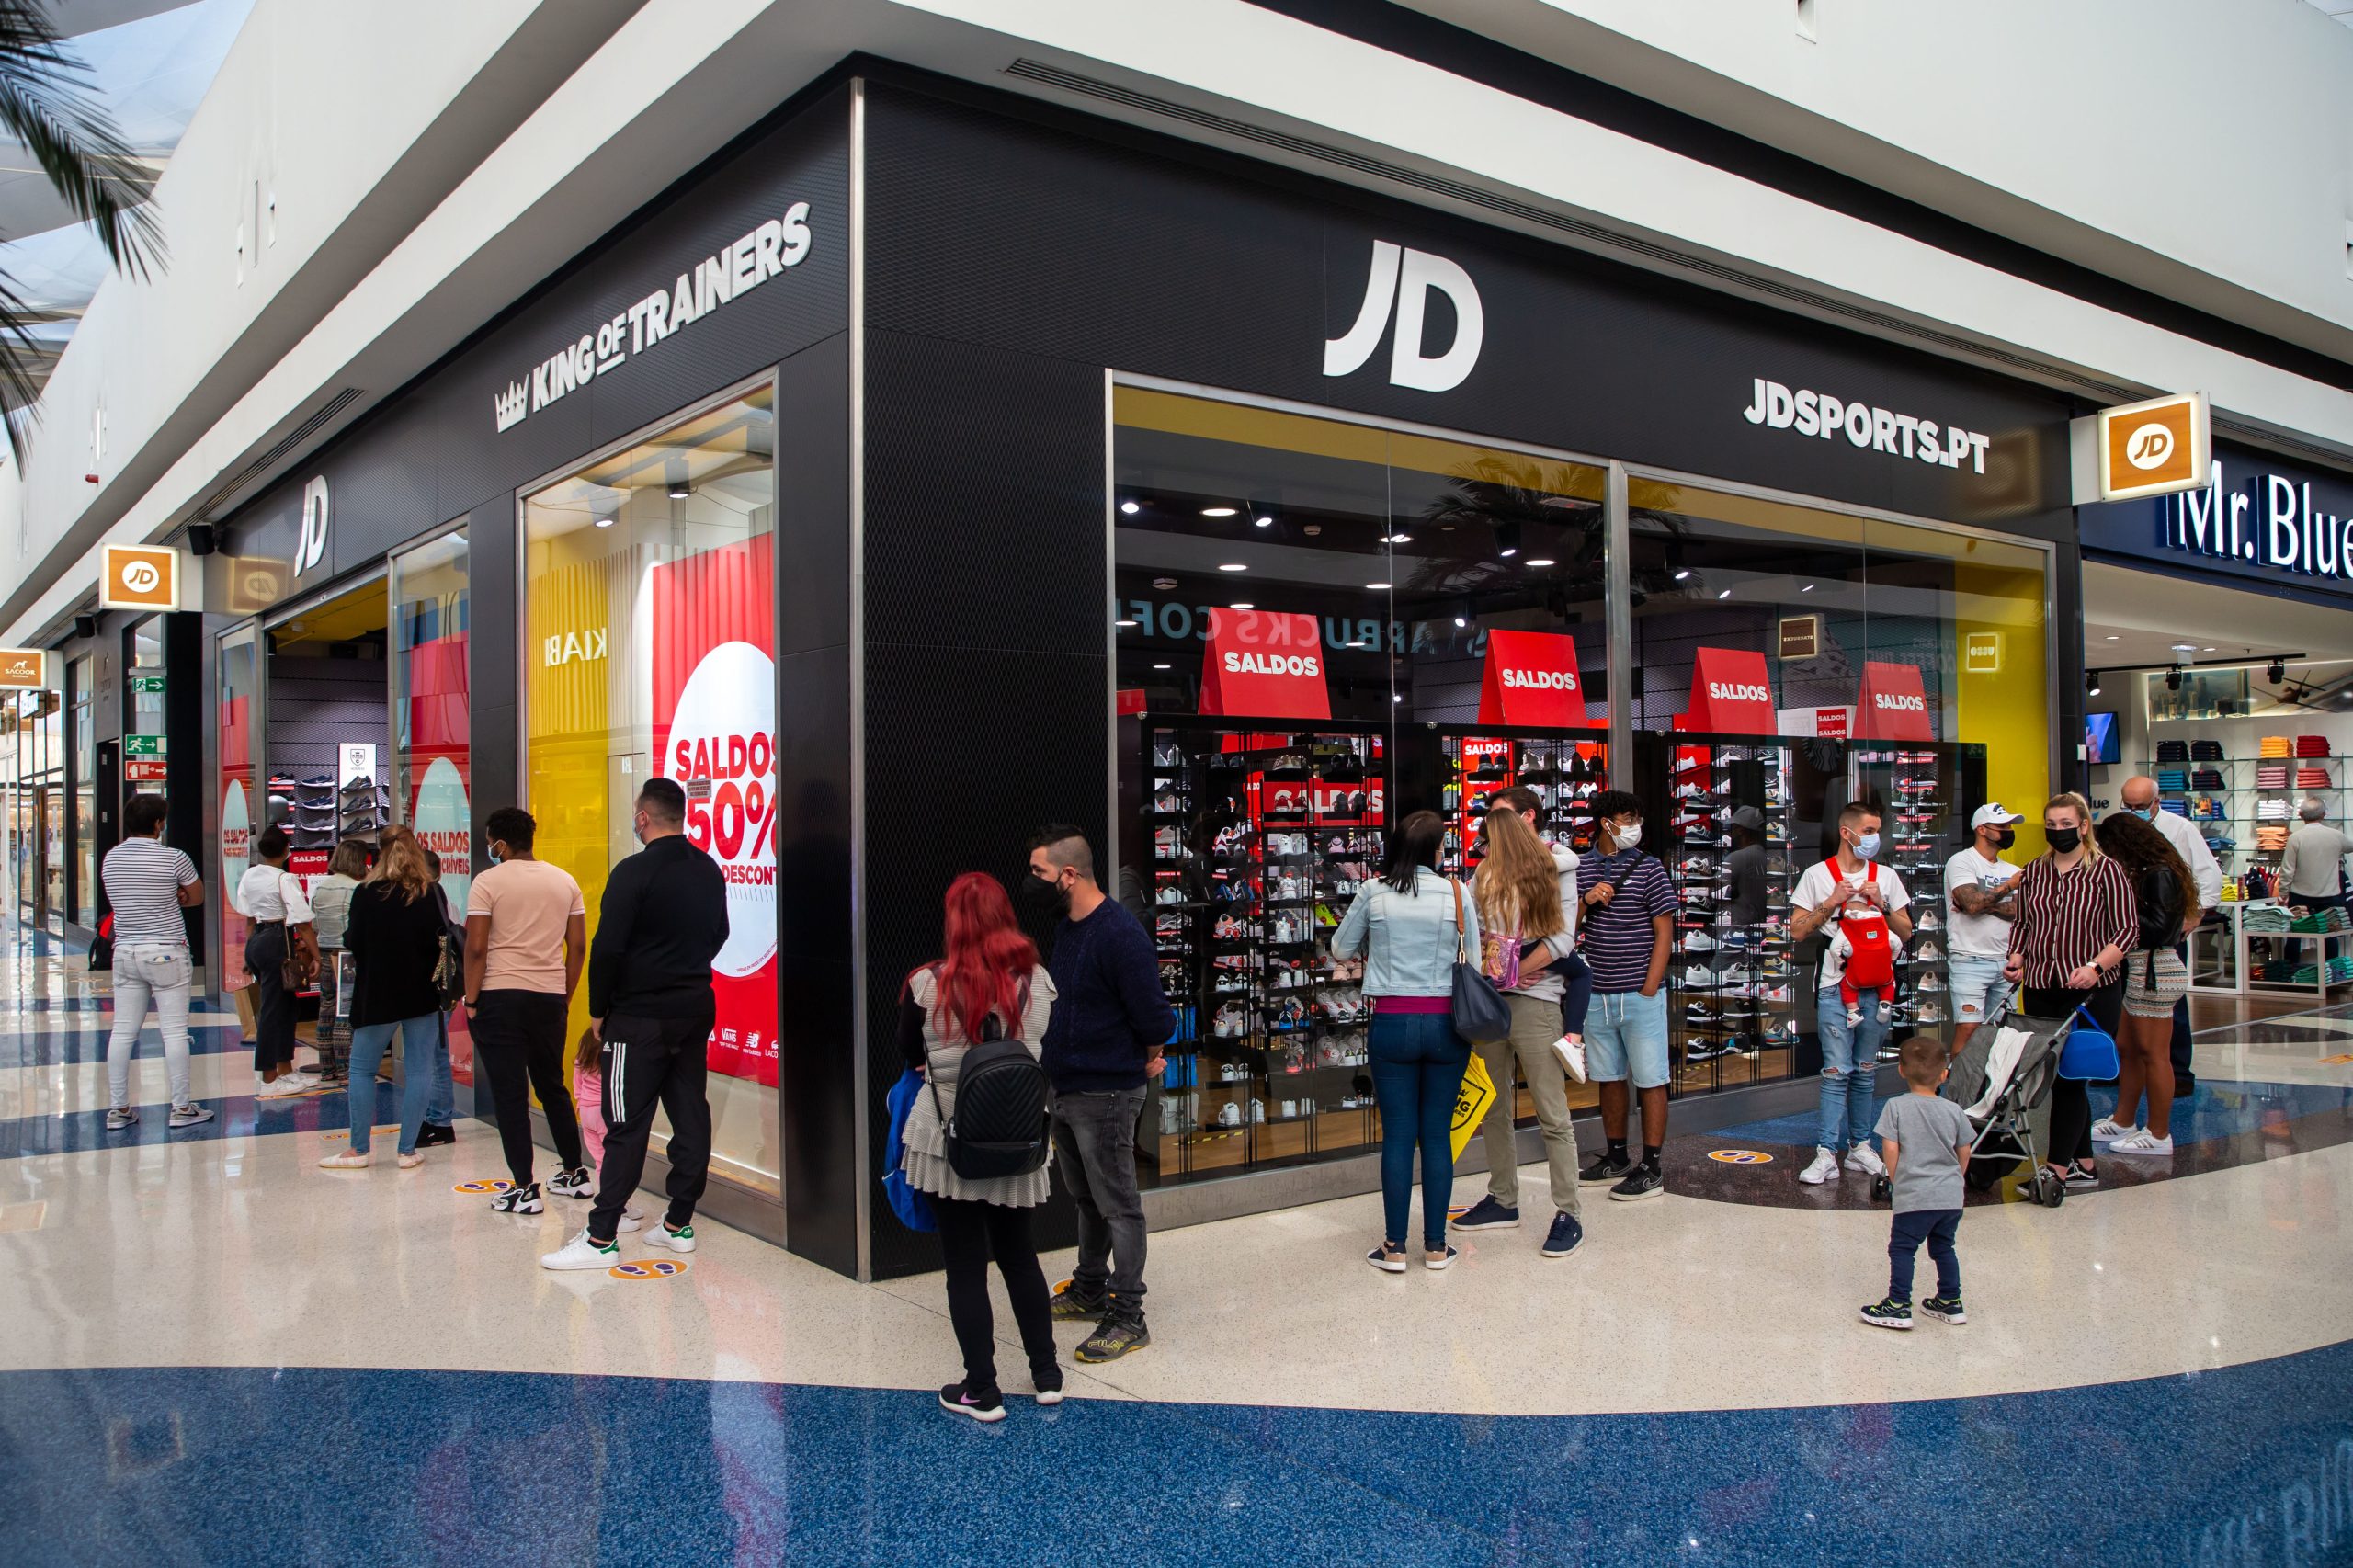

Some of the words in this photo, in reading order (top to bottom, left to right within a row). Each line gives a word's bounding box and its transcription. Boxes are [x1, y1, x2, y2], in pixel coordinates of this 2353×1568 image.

[532, 335, 595, 414] KING
[597, 312, 627, 361] OF
[628, 201, 812, 356] TRAINERS
[1323, 240, 1483, 392] JD
[1743, 378, 1990, 475] JDSPORTS.PT
[2134, 432, 2168, 460] JD
[2177, 460, 2255, 560] Mr.
[295, 474, 329, 578] JD
[128, 568, 154, 585] JD
[1225, 651, 1319, 676] SALDOS
[1503, 668, 1575, 690] SALDOS
[1710, 681, 1768, 702] SALDOS
[1875, 693, 1925, 711] SALDOS
[1465, 742, 1508, 755] SALDOS
[687, 780, 778, 861] 50%
[416, 831, 429, 851] OS
[430, 831, 470, 853] SALDOS
[441, 855, 470, 875] CRÍVEIS
[721, 1028, 736, 1042] VANS
[764, 1049, 779, 1059] LACO
